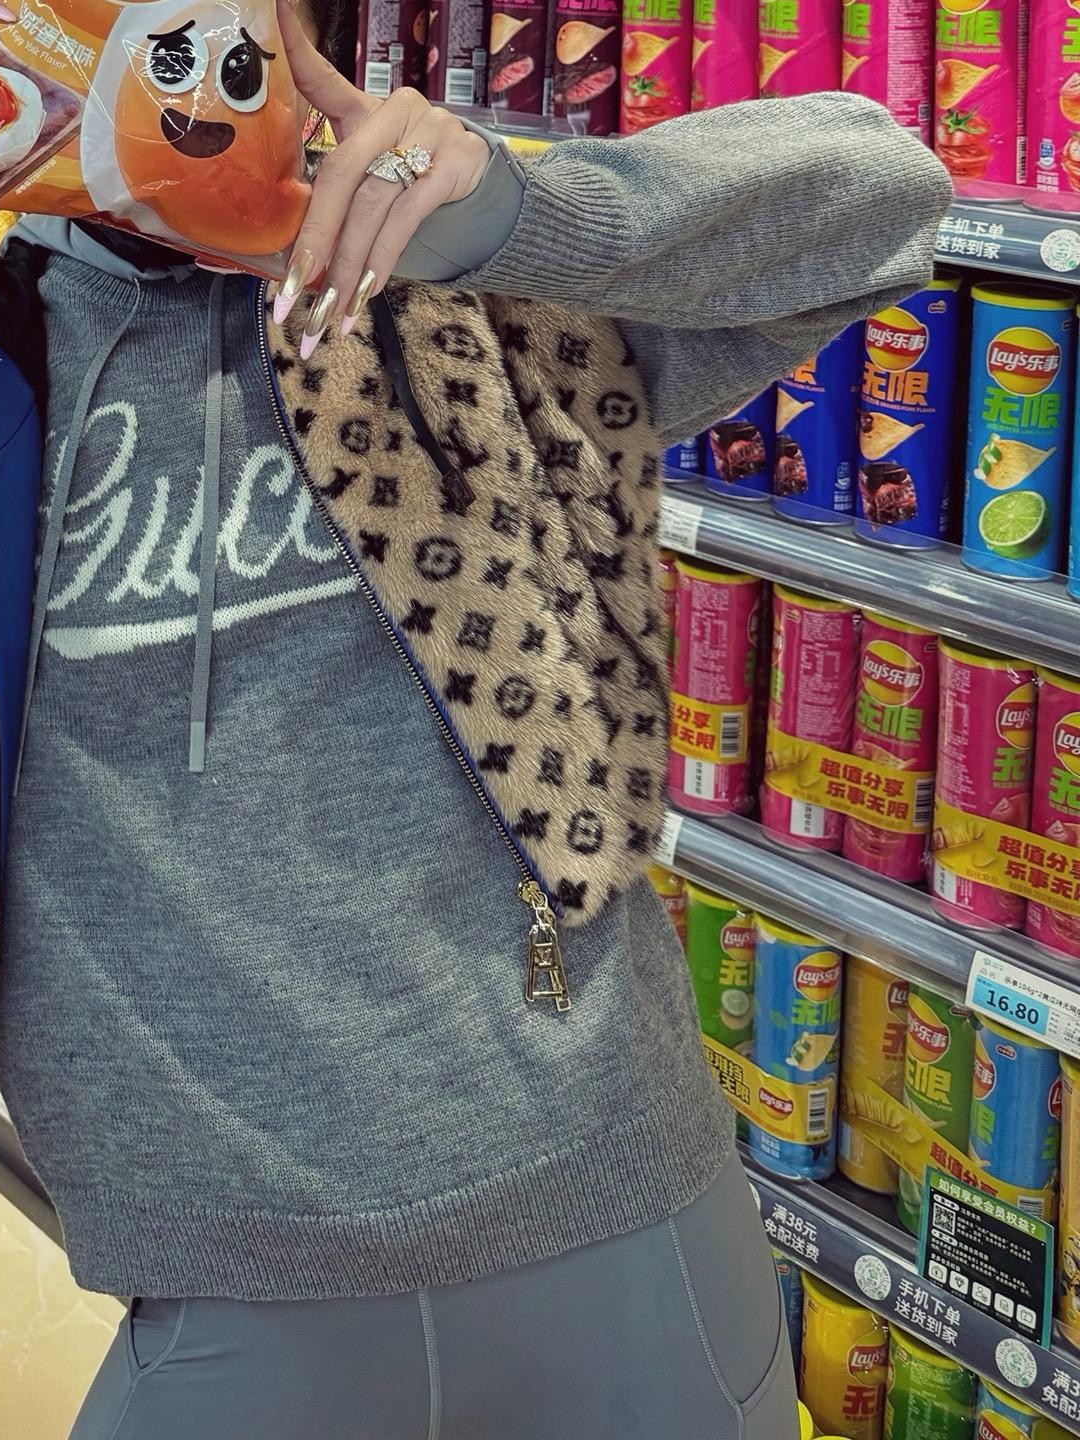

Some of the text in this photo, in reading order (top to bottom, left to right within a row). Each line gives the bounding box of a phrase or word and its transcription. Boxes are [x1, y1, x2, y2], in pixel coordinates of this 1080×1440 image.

[936, 9, 1001, 46] 无限
[40, 50, 68, 70] Flavor
[934, 234, 1001, 259] 送货到家
[938, 216, 1005, 239] 手机下单
[867, 324, 926, 351] Lay's乐事
[989, 347, 1059, 372] Lay's乐事
[862, 361, 930, 406] 无限
[982, 385, 1061, 429] 无限
[863, 655, 922, 689] Lay's乐事
[856, 692, 925, 742] 无限
[819, 756, 906, 799] 超值分享
[825, 780, 911, 822] 乐事无限
[986, 990, 1039, 1024] 16.80
[772, 1202, 818, 1242] 满38元
[938, 1178, 1037, 1235] 如何享受会员权益?
[764, 1218, 819, 1264] 免配送费
[898, 1278, 961, 1327] 手机下单
[894, 1299, 959, 1347] 送货到家
[1041, 1385, 1080, 1422] 免配
